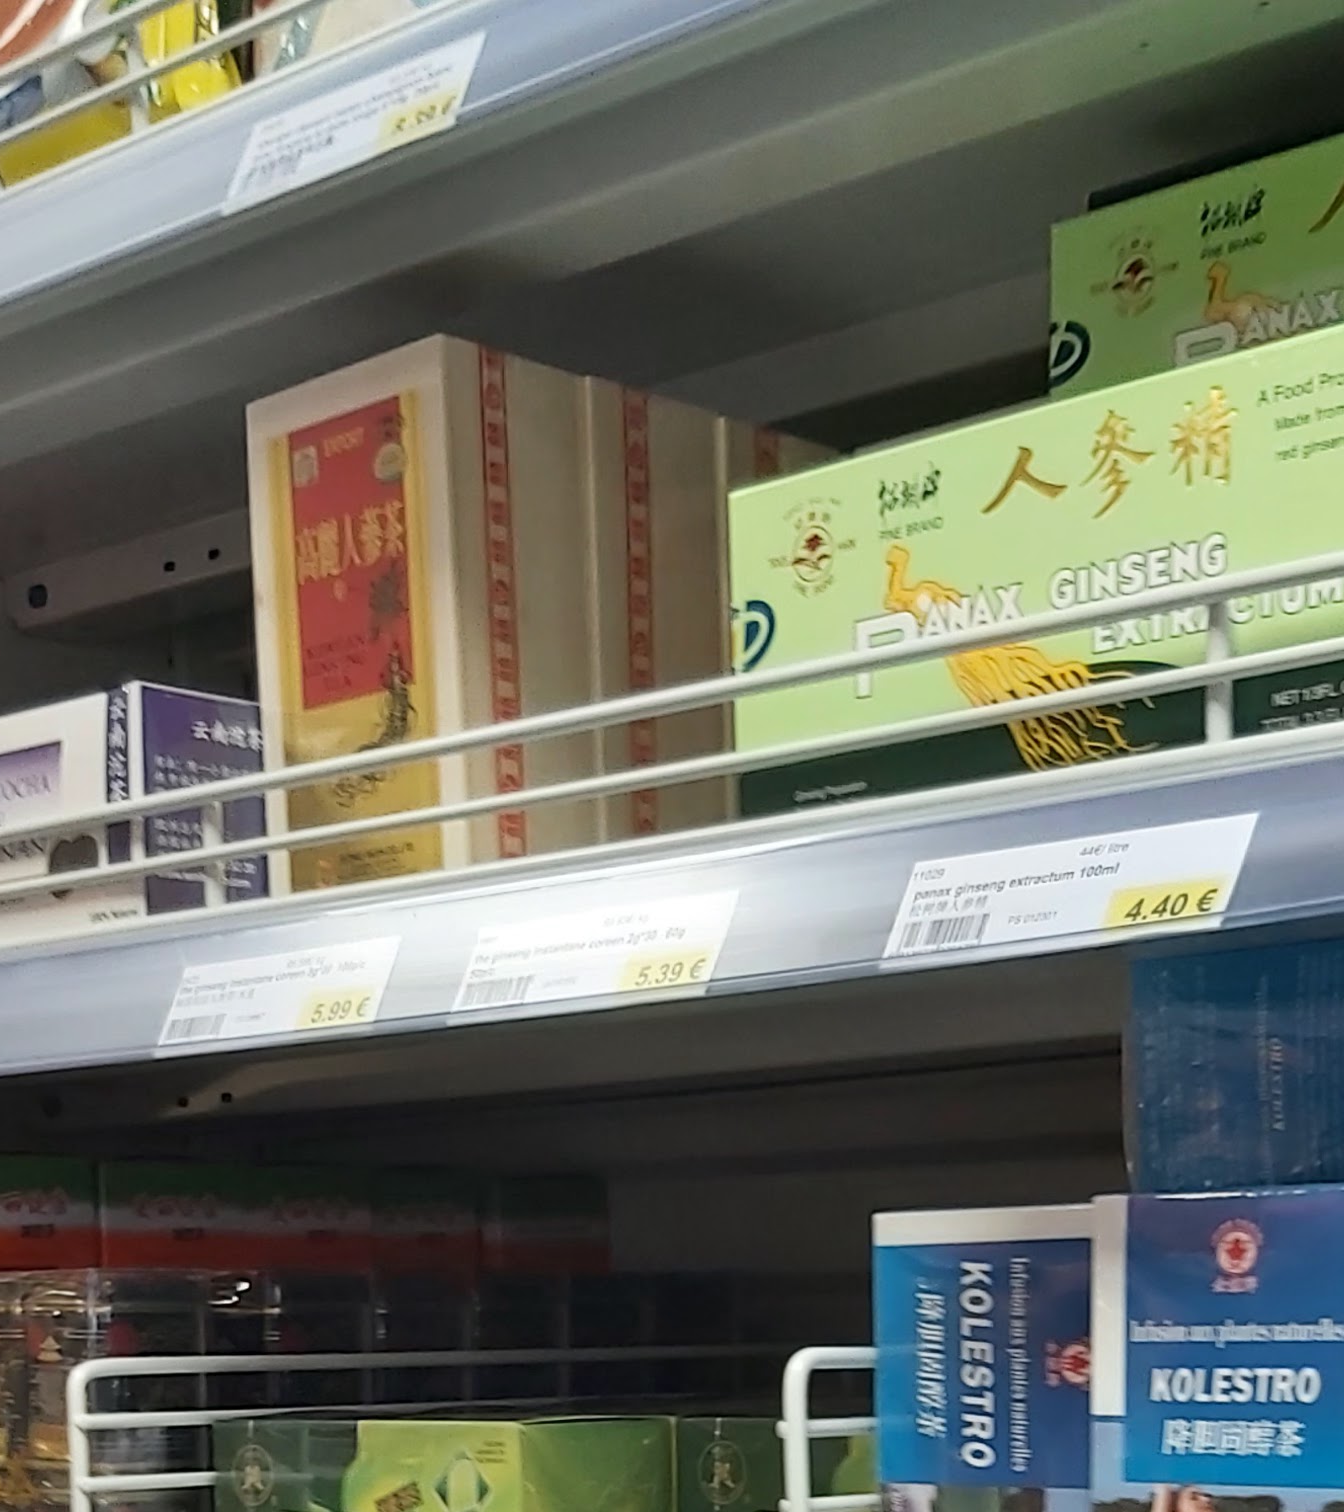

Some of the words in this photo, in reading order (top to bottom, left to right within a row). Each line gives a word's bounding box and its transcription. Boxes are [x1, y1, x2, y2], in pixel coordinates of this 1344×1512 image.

[1273, 377, 1315, 402] Food
[1048, 531, 1229, 613] GINSENG
[913, 887, 953, 902] panax
[954, 879, 1007, 899] ginseng
[1008, 869, 1076, 889] extractum
[1079, 861, 1121, 879] 100ml
[1123, 892, 1190, 923] 4.40
[1195, 887, 1219, 914] €
[634, 960, 683, 987] 5.39
[688, 957, 707, 980] €
[310, 999, 353, 1025] 5.99
[356, 996, 371, 1019] €
[958, 1259, 998, 1470] KOLESTRO
[1149, 1366, 1323, 1404] KOLESTRO
